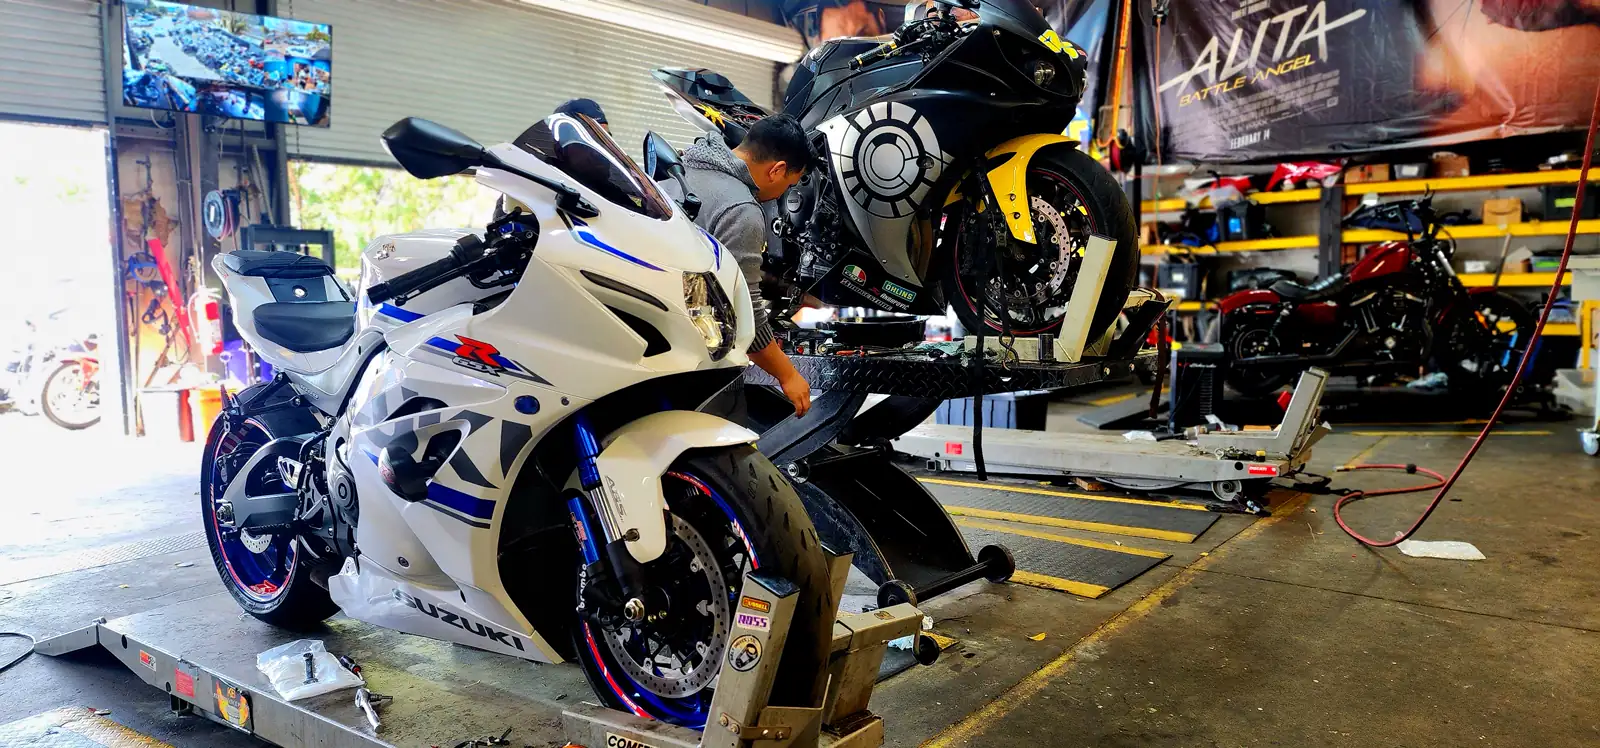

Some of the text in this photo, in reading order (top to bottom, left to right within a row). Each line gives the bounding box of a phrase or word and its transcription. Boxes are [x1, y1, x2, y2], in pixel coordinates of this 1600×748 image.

[1158, 0, 1367, 97] ALITA
[1179, 75, 1247, 107] BATTLE
[1250, 54, 1316, 85] ANGEL
[1230, 128, 1271, 149] FEBRUARY 14
[392, 588, 525, 652] SUZUKI
